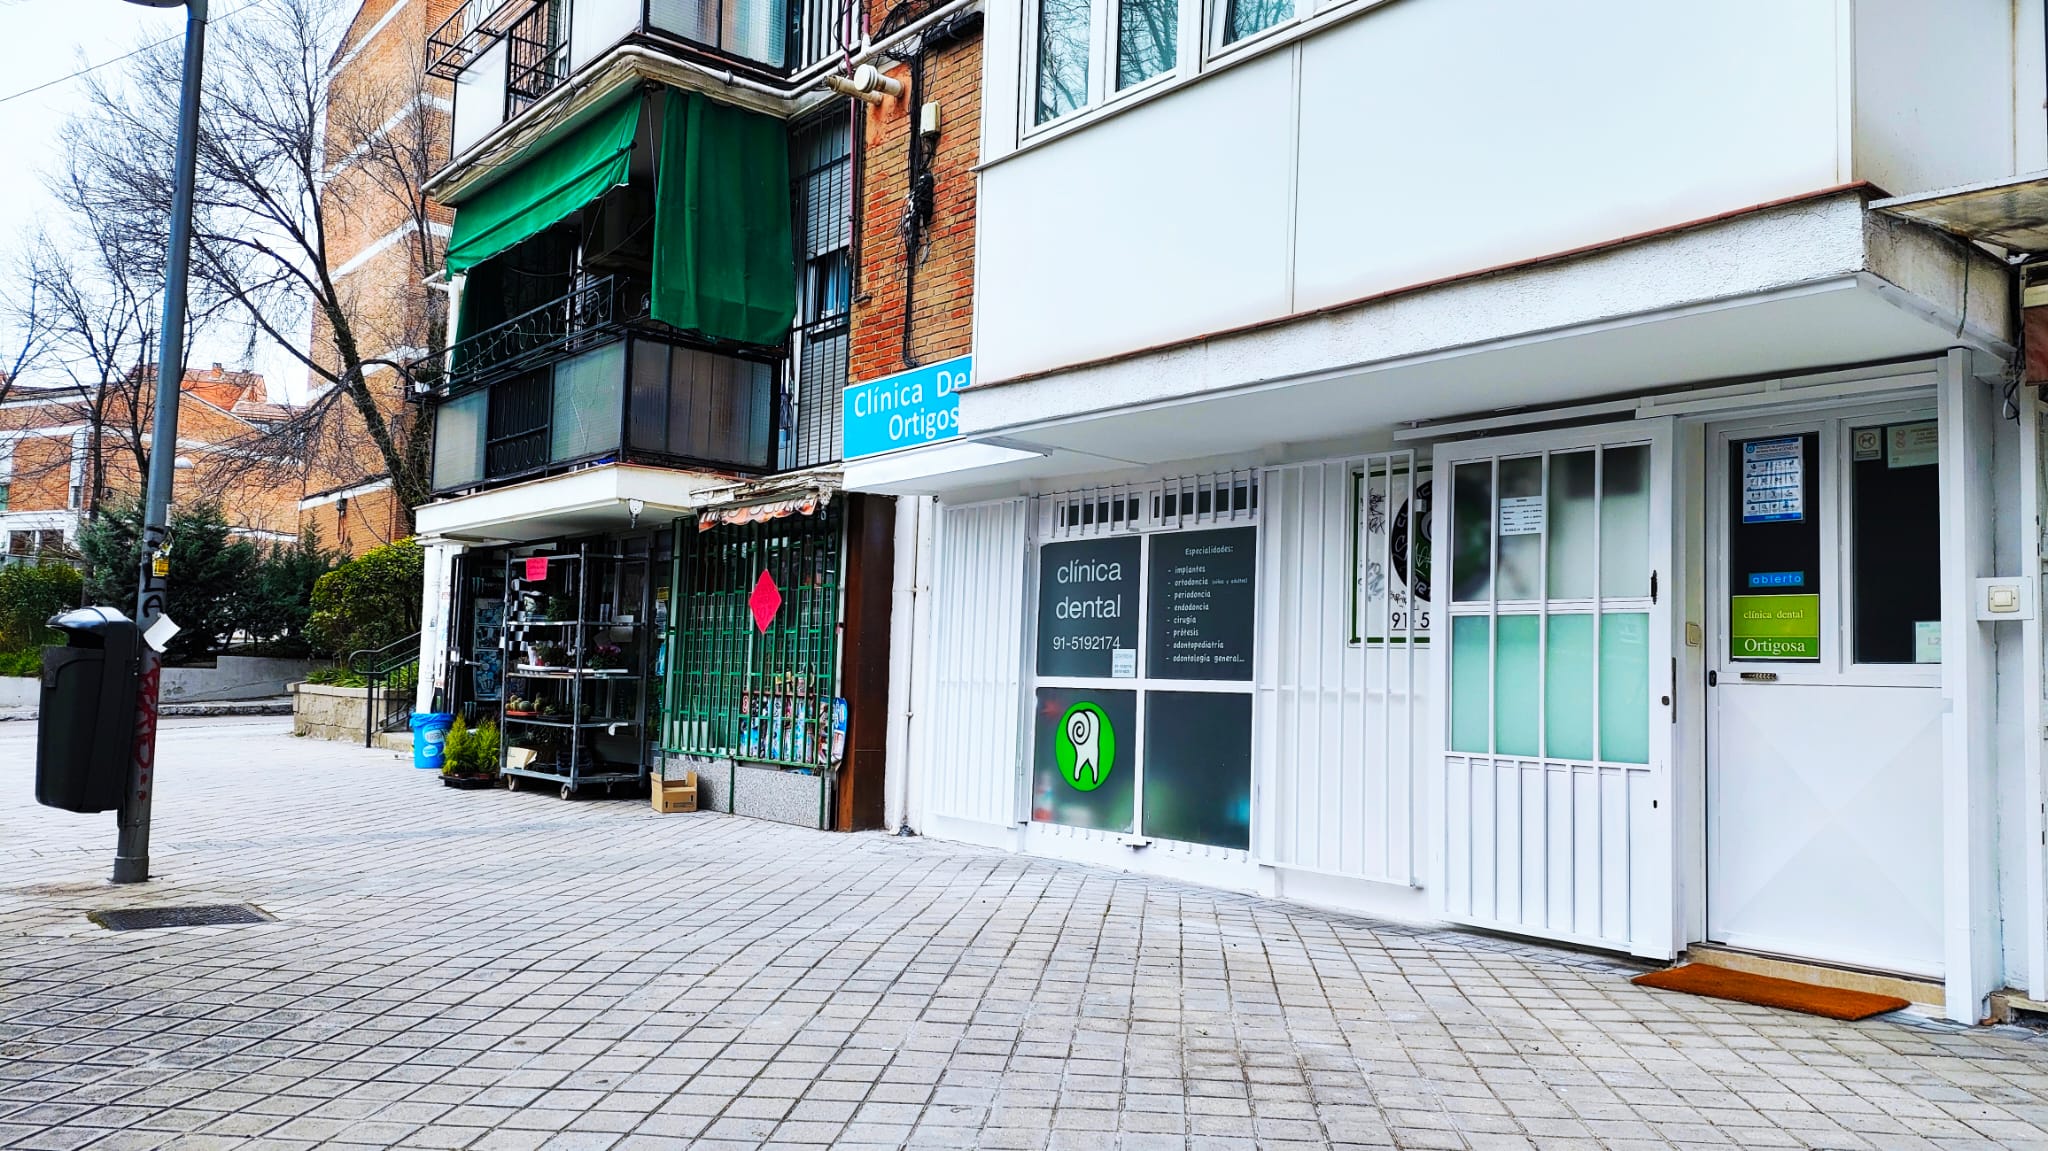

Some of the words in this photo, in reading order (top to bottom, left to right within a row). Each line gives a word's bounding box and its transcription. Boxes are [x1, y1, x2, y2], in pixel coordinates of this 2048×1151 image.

[854, 382, 923, 417] Clínica
[1184, 545, 1234, 557] Especialidades:
[1057, 558, 1122, 584] clínica
[1174, 565, 1206, 575] implantes
[1174, 577, 1209, 587] ortodoncia
[1751, 574, 1802, 585] abierto
[1174, 590, 1211, 600] periodoncia
[1055, 593, 1121, 619] dental
[1174, 602, 1209, 611] endodoncia
[1743, 610, 1773, 619] clínica
[1776, 609, 1803, 619] dental
[1173, 615, 1197, 625] cirugía
[1053, 636, 1121, 650] 91-5192174
[1173, 640, 1224, 651] odontopediatría
[1744, 638, 1806, 655] Ortigosa
[1173, 653, 1211, 663] odontología
